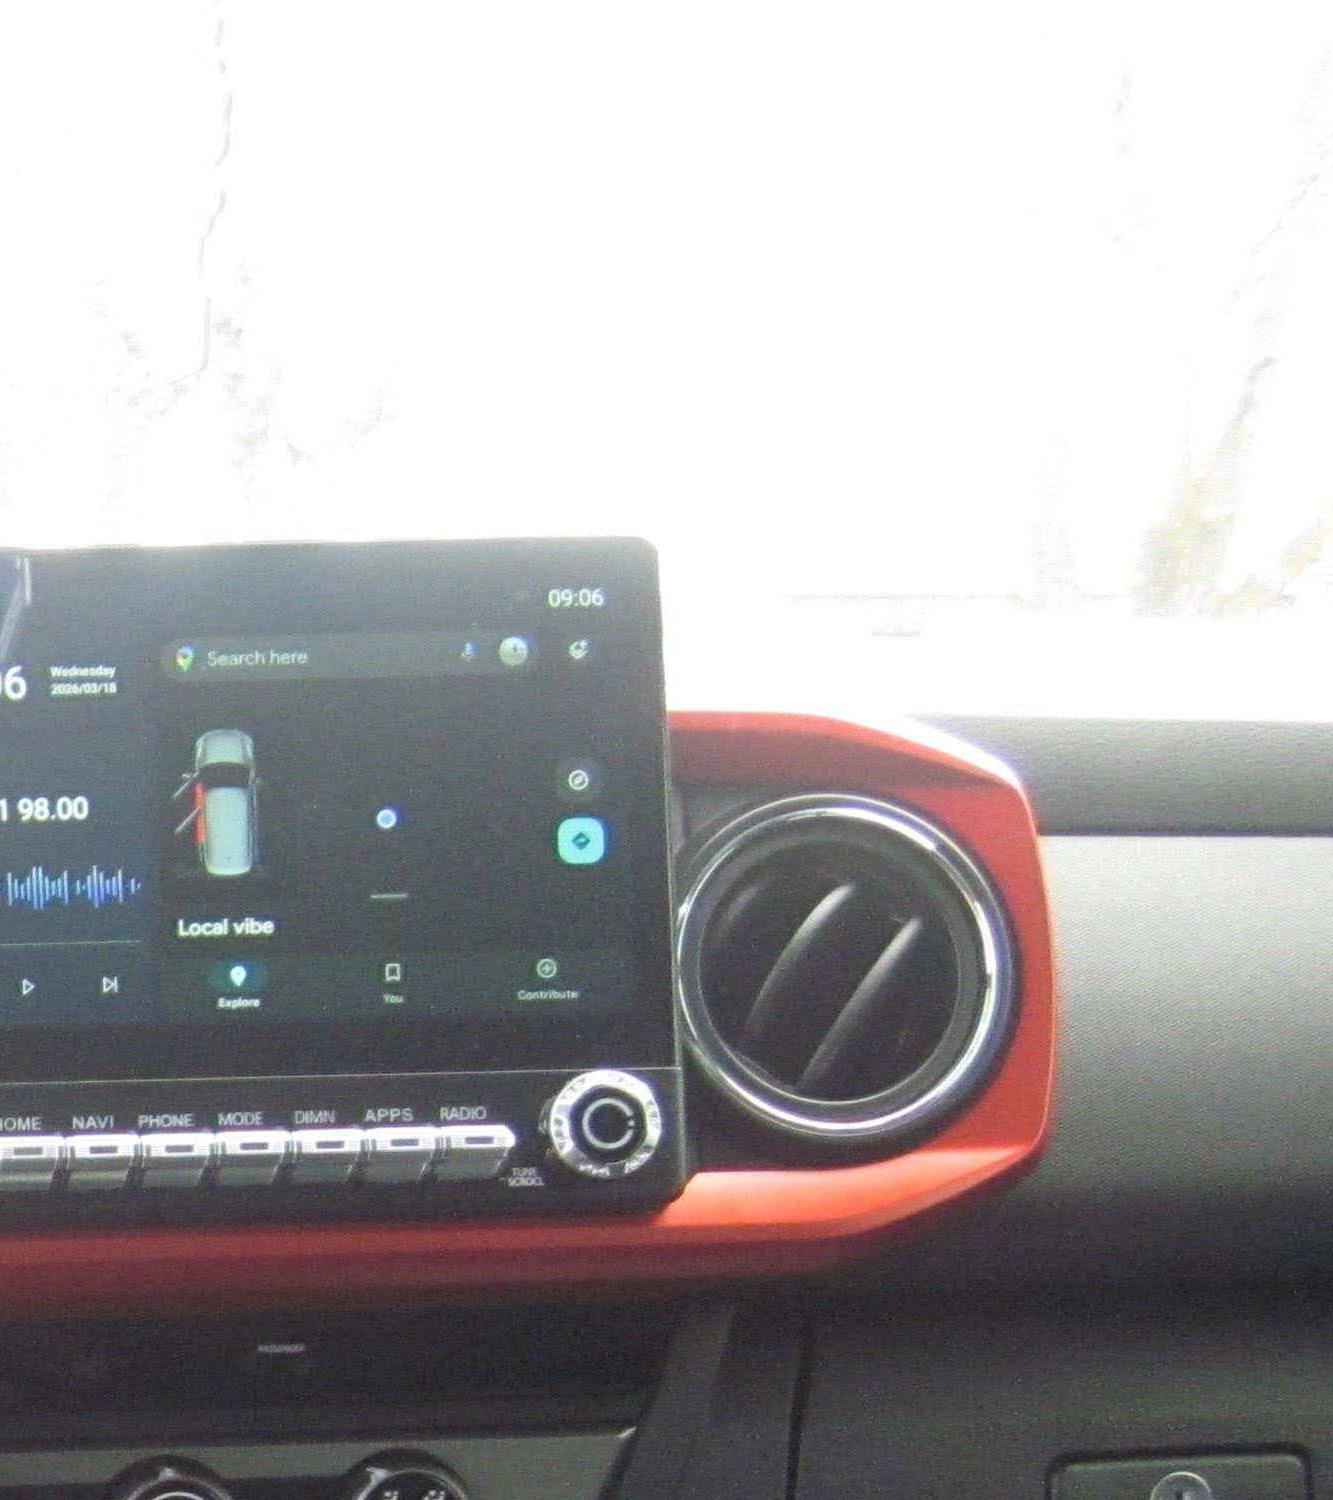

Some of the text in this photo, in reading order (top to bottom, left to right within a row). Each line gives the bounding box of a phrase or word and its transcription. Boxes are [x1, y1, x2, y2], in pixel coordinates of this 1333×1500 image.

[548, 588, 604, 608] 09:06
[207, 649, 308, 667] Search here
[50, 665, 117, 679] Wednesday
[50, 682, 117, 695] 2026/03/18
[17, 796, 89, 821] 98.00
[177, 917, 274, 937] Local vibe
[517, 988, 578, 1001] Contribute
[218, 997, 261, 1009] Explore
[138, 1113, 194, 1128] PHONE
[218, 1111, 263, 1126] MODE
[364, 1108, 413, 1122] APPS
[440, 1107, 487, 1121] RADIO
[72, 1115, 114, 1129] NAVI
